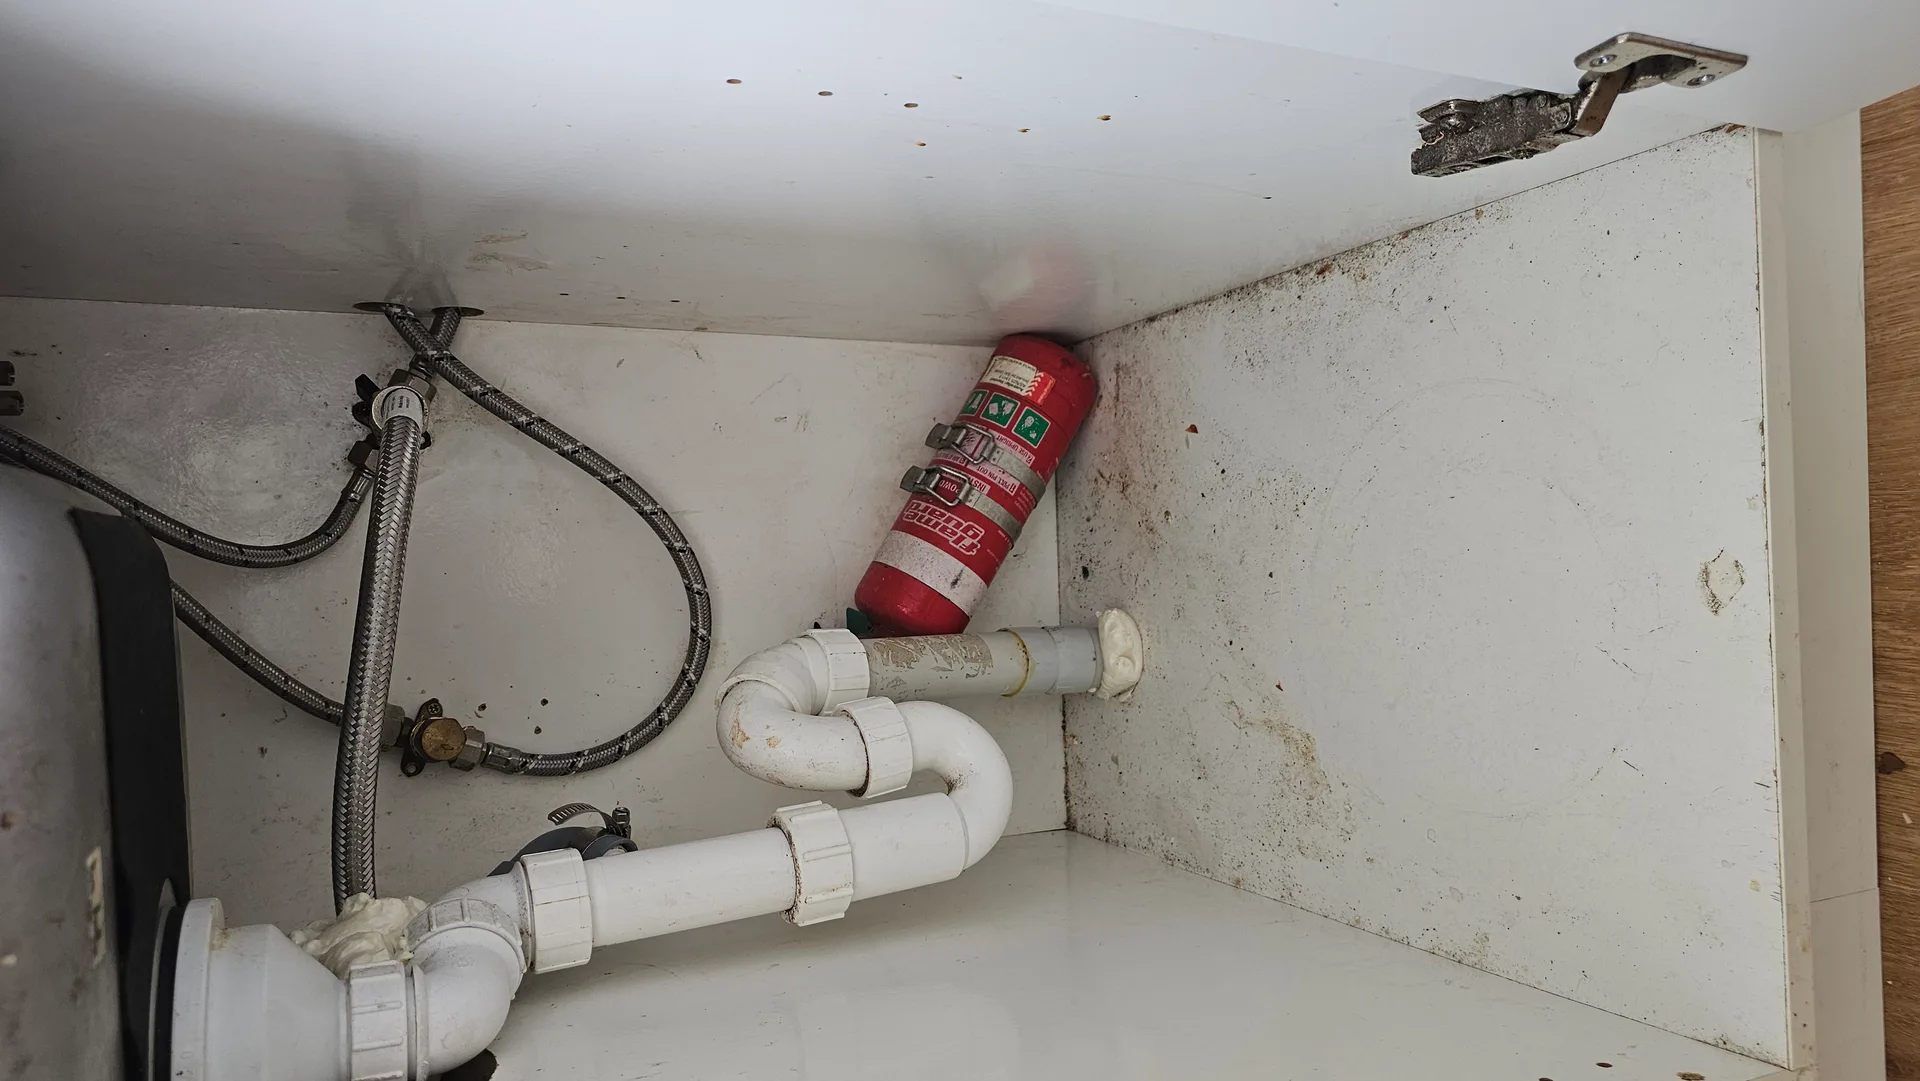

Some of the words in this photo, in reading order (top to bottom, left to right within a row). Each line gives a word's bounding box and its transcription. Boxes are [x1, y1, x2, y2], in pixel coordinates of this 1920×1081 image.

[995, 434, 1019, 451] UPRIGHT
[1018, 447, 1029, 458] USE
[1025, 454, 1034, 465] 2
[976, 465, 989, 475] OUT
[987, 471, 998, 481] PIN
[996, 476, 1011, 489] PULL
[903, 499, 986, 542] guard
[902, 510, 981, 557] flame
